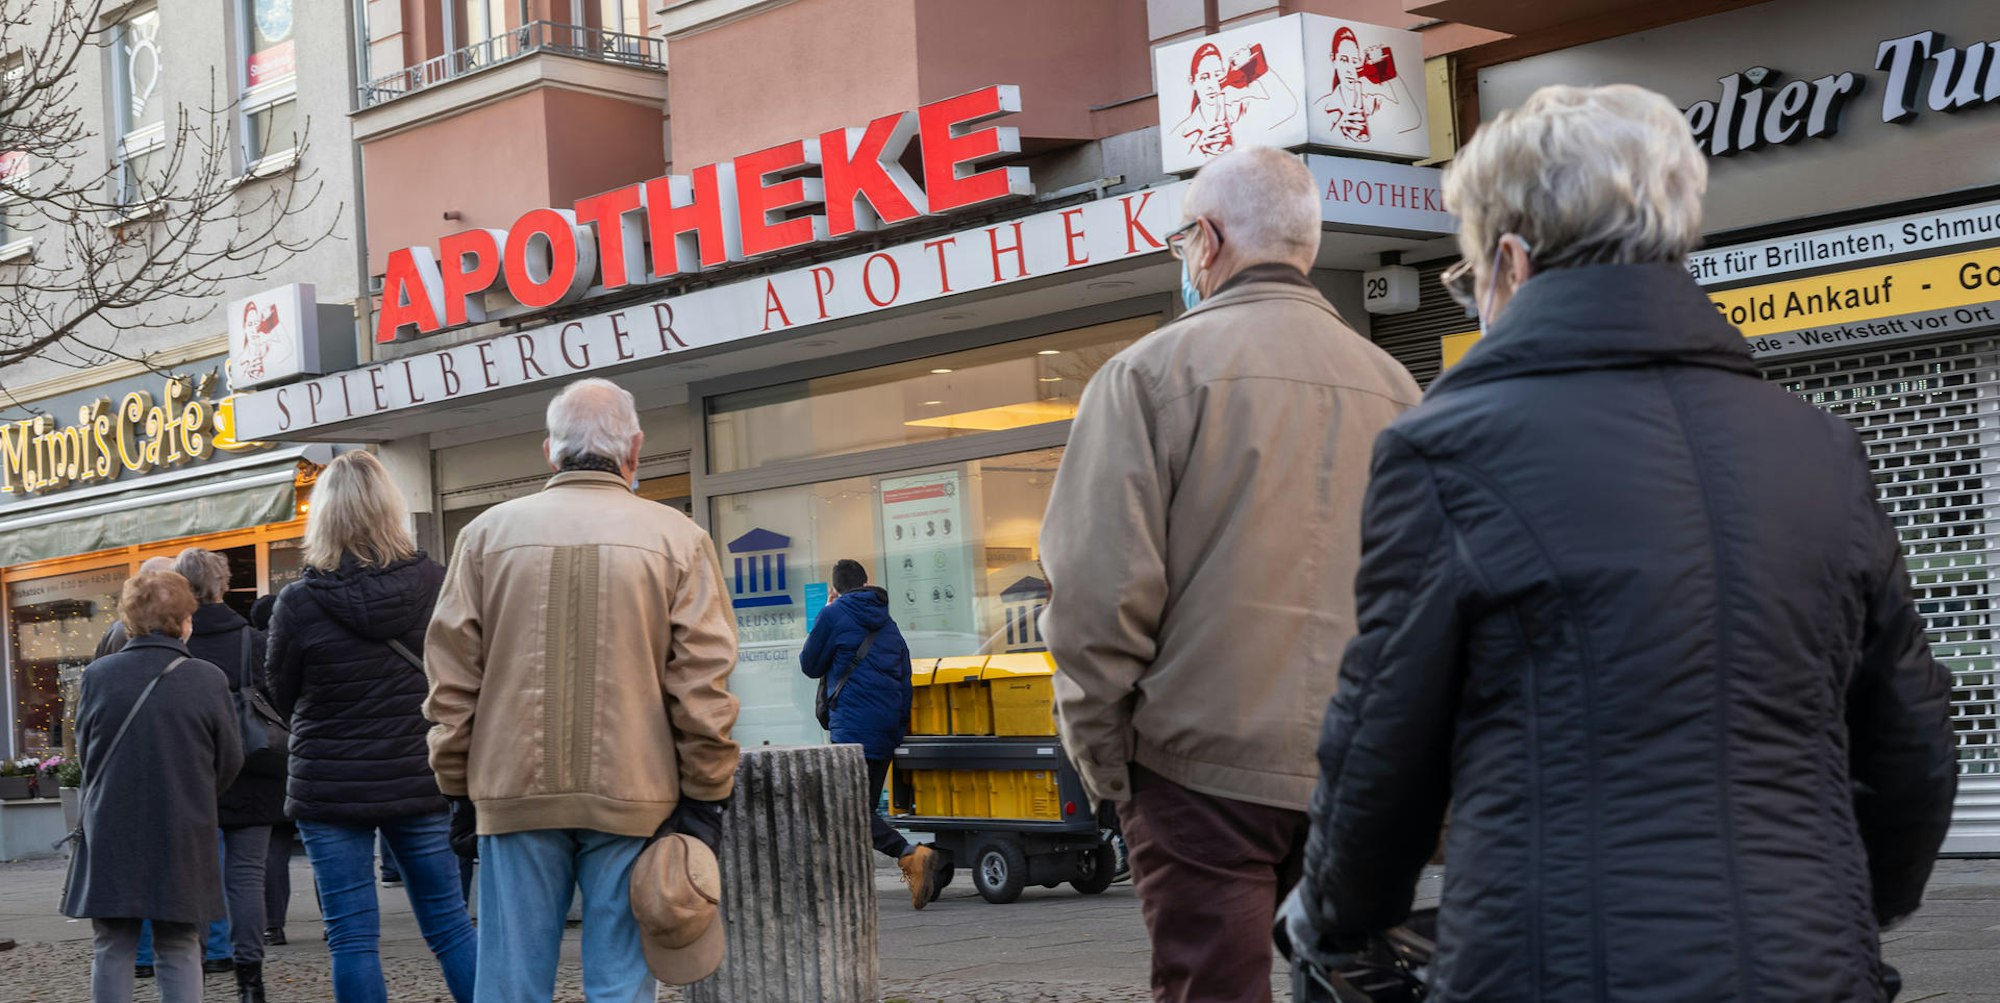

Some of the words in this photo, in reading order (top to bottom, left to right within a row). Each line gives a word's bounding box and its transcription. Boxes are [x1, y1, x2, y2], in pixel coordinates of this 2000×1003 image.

[376, 84, 1014, 344] APOTHEKE
[1724, 251, 1758, 275] für
[1766, 232, 1895, 268] Brillanten,
[1367, 277, 1388, 300] 29
[1783, 276, 1893, 319] Ankauf
[276, 302, 688, 431] SPIELBERGER
[761, 191, 1167, 332] APOTHEK
[1798, 318, 1908, 346] Werkstatt
[1910, 315, 1948, 330] vor
[1954, 306, 1995, 324] Ort
[0, 398, 111, 493] Mimi's
[116, 373, 211, 472] Café
[738, 612, 796, 628] REUSSEN
